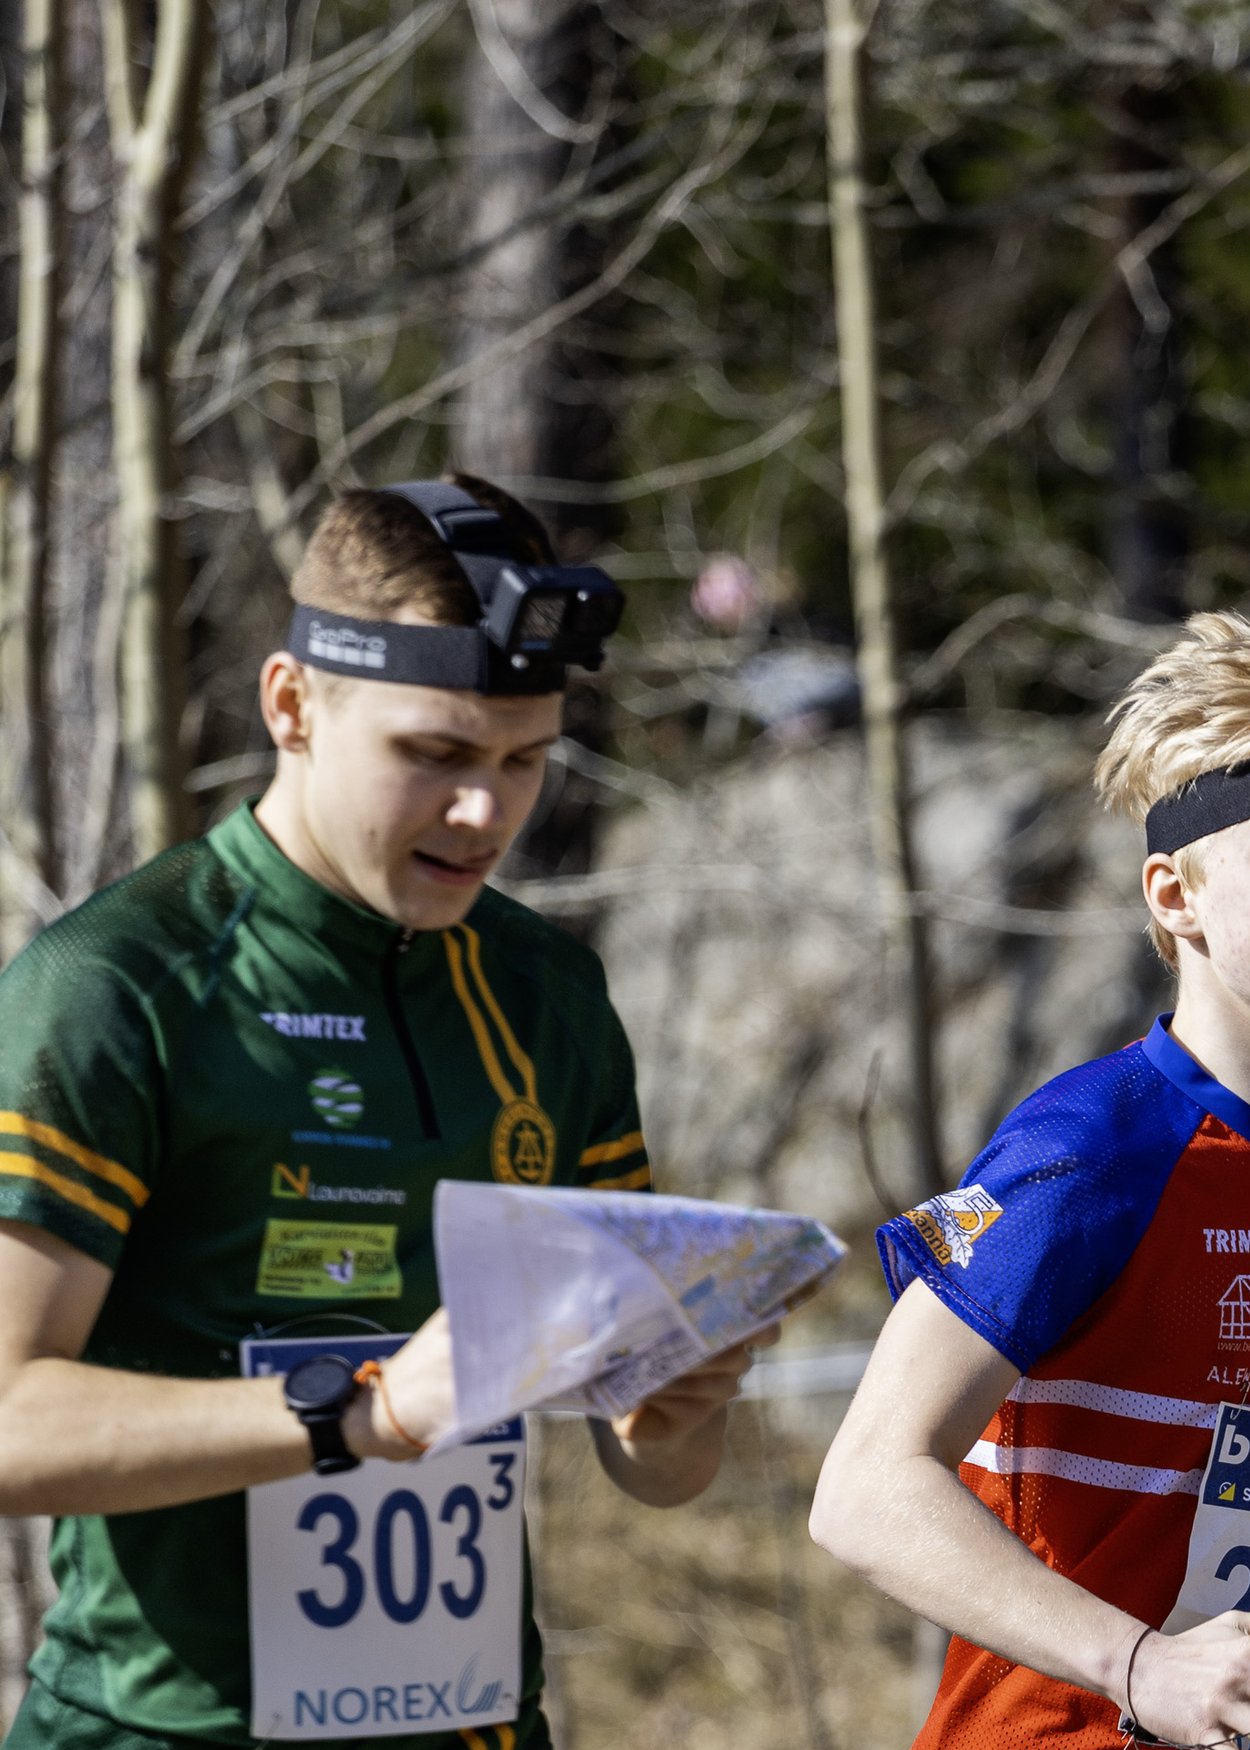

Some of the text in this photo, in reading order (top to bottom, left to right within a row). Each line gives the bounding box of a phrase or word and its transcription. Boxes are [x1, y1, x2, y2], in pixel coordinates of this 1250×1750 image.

[260, 1012, 367, 1042] TRIMTEX
[906, 1209, 950, 1261] anna
[296, 1453, 516, 1629] 303 3
[294, 1680, 452, 1727] NOREX
